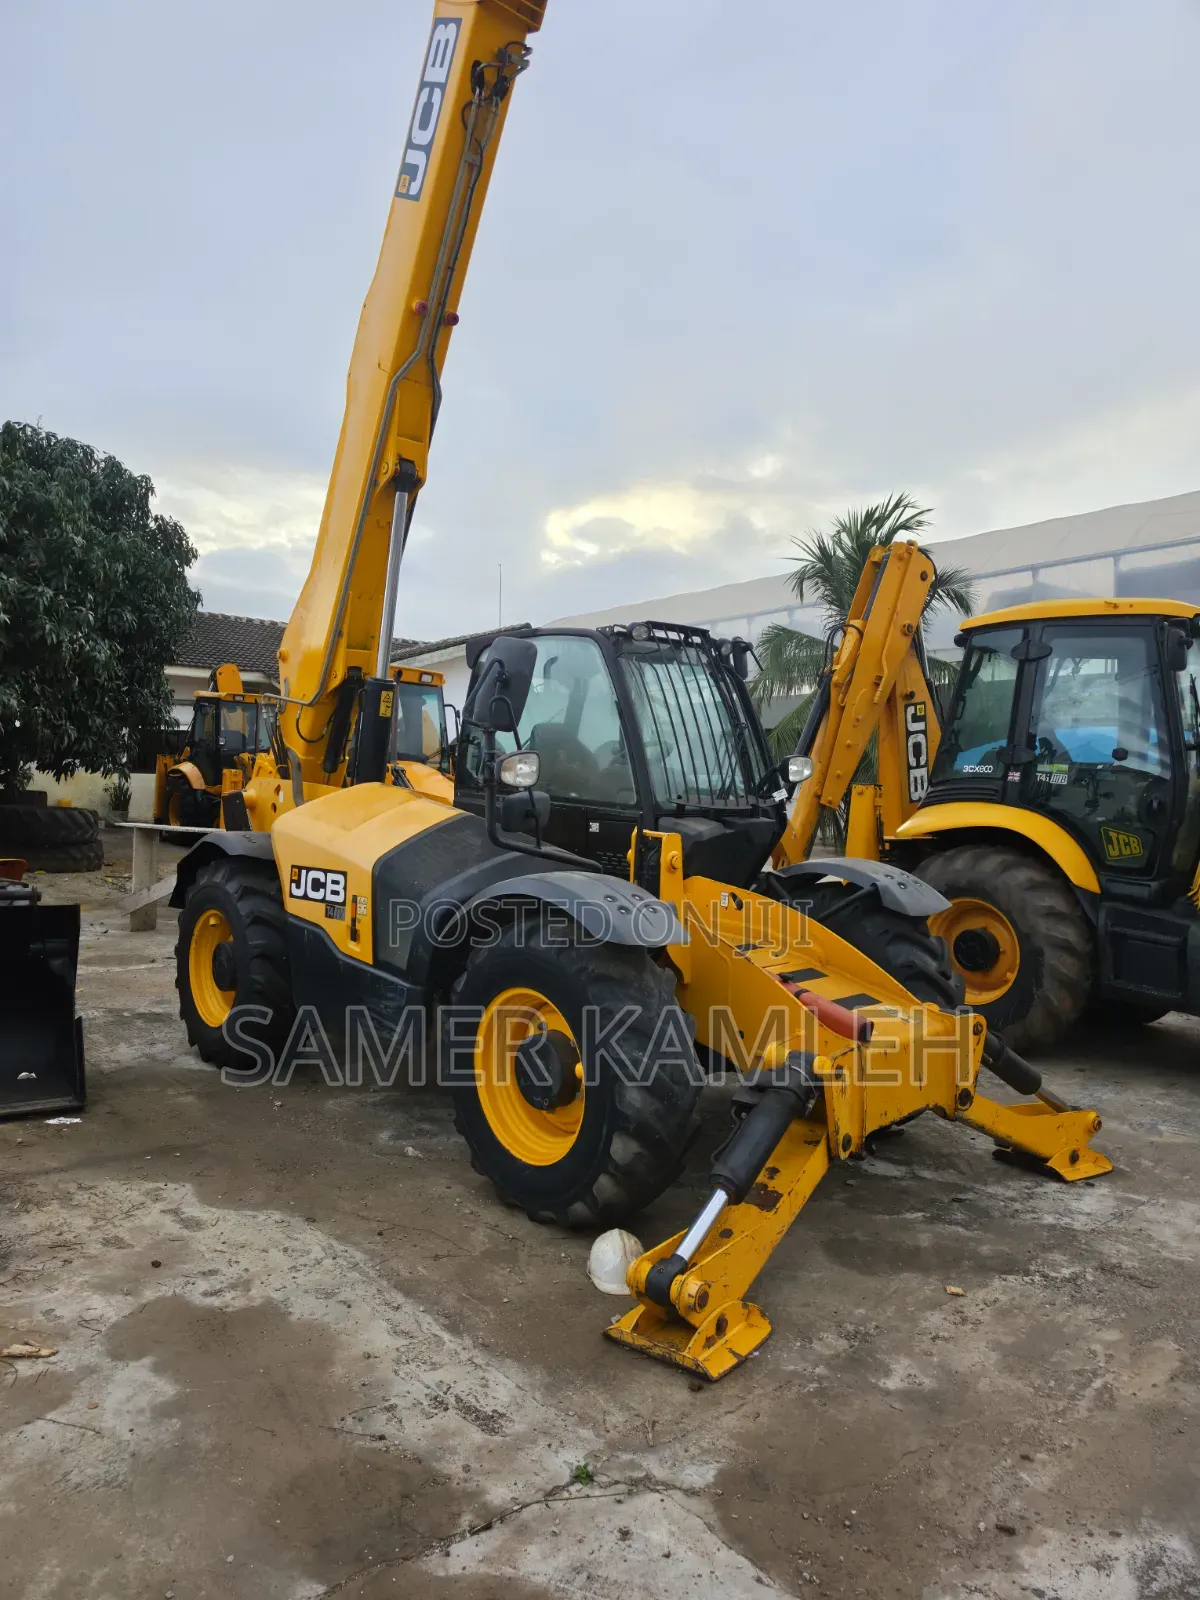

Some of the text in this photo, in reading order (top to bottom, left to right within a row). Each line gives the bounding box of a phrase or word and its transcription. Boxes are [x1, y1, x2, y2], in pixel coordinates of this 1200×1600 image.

[405, 22, 457, 196] JCB
[906, 705, 929, 801] JCB
[1107, 831, 1141, 857] JCB
[291, 869, 346, 903] JCB
